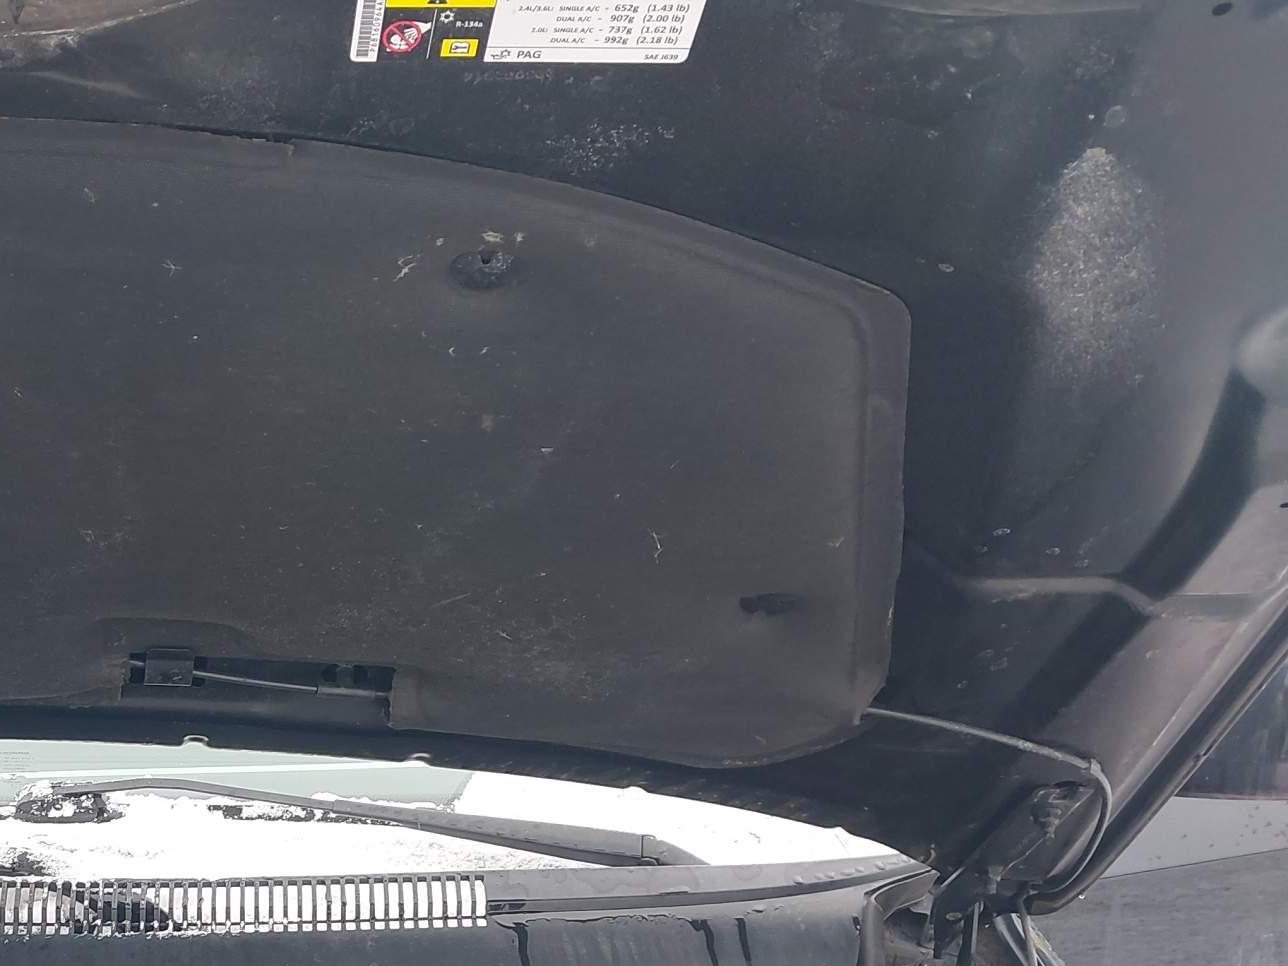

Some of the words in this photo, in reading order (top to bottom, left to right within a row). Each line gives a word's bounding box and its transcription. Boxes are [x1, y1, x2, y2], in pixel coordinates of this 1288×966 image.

[614, 4, 639, 14] 652g
[647, 4, 674, 13] (1.43
[676, 4, 690, 13] lb)
[610, 14, 634, 24] 907g
[643, 14, 669, 23] (2.00
[671, 14, 685, 23] lb)
[455, 20, 484, 29] R-134a
[608, 26, 632, 35] 737g
[640, 26, 666, 35] (1.62
[669, 26, 683, 35] lb)
[604, 36, 629, 45] 992g
[636, 36, 662, 45] (2.18
[664, 36, 678, 45] lb)
[516, 50, 542, 59] PAG
